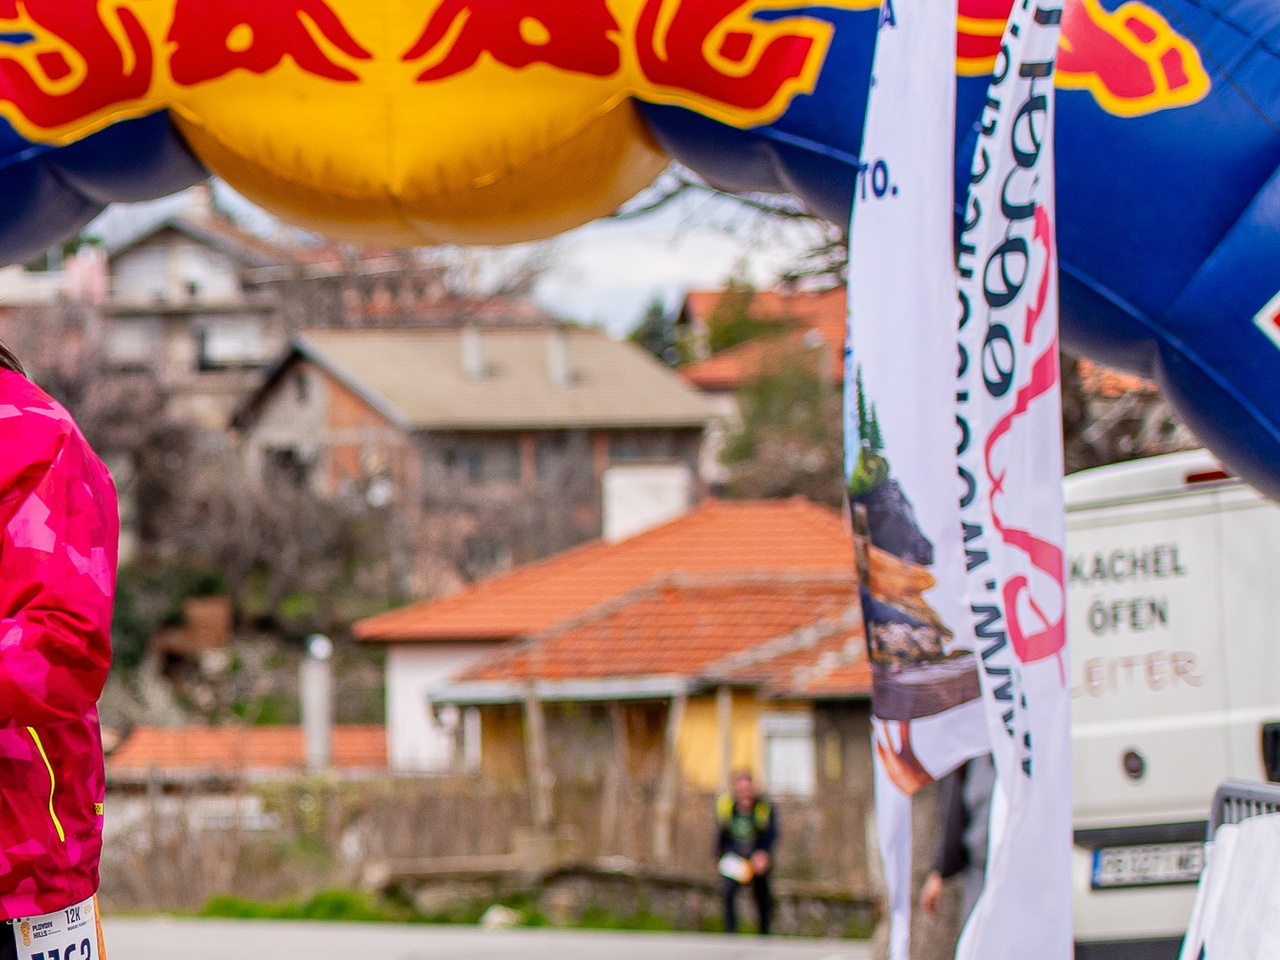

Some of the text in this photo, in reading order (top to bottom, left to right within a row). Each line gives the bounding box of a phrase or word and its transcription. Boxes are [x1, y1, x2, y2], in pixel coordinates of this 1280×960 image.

[1068, 544, 1187, 584] KACHEL
[1070, 650, 1205, 698] EITER
[65, 907, 81, 924] 12K
